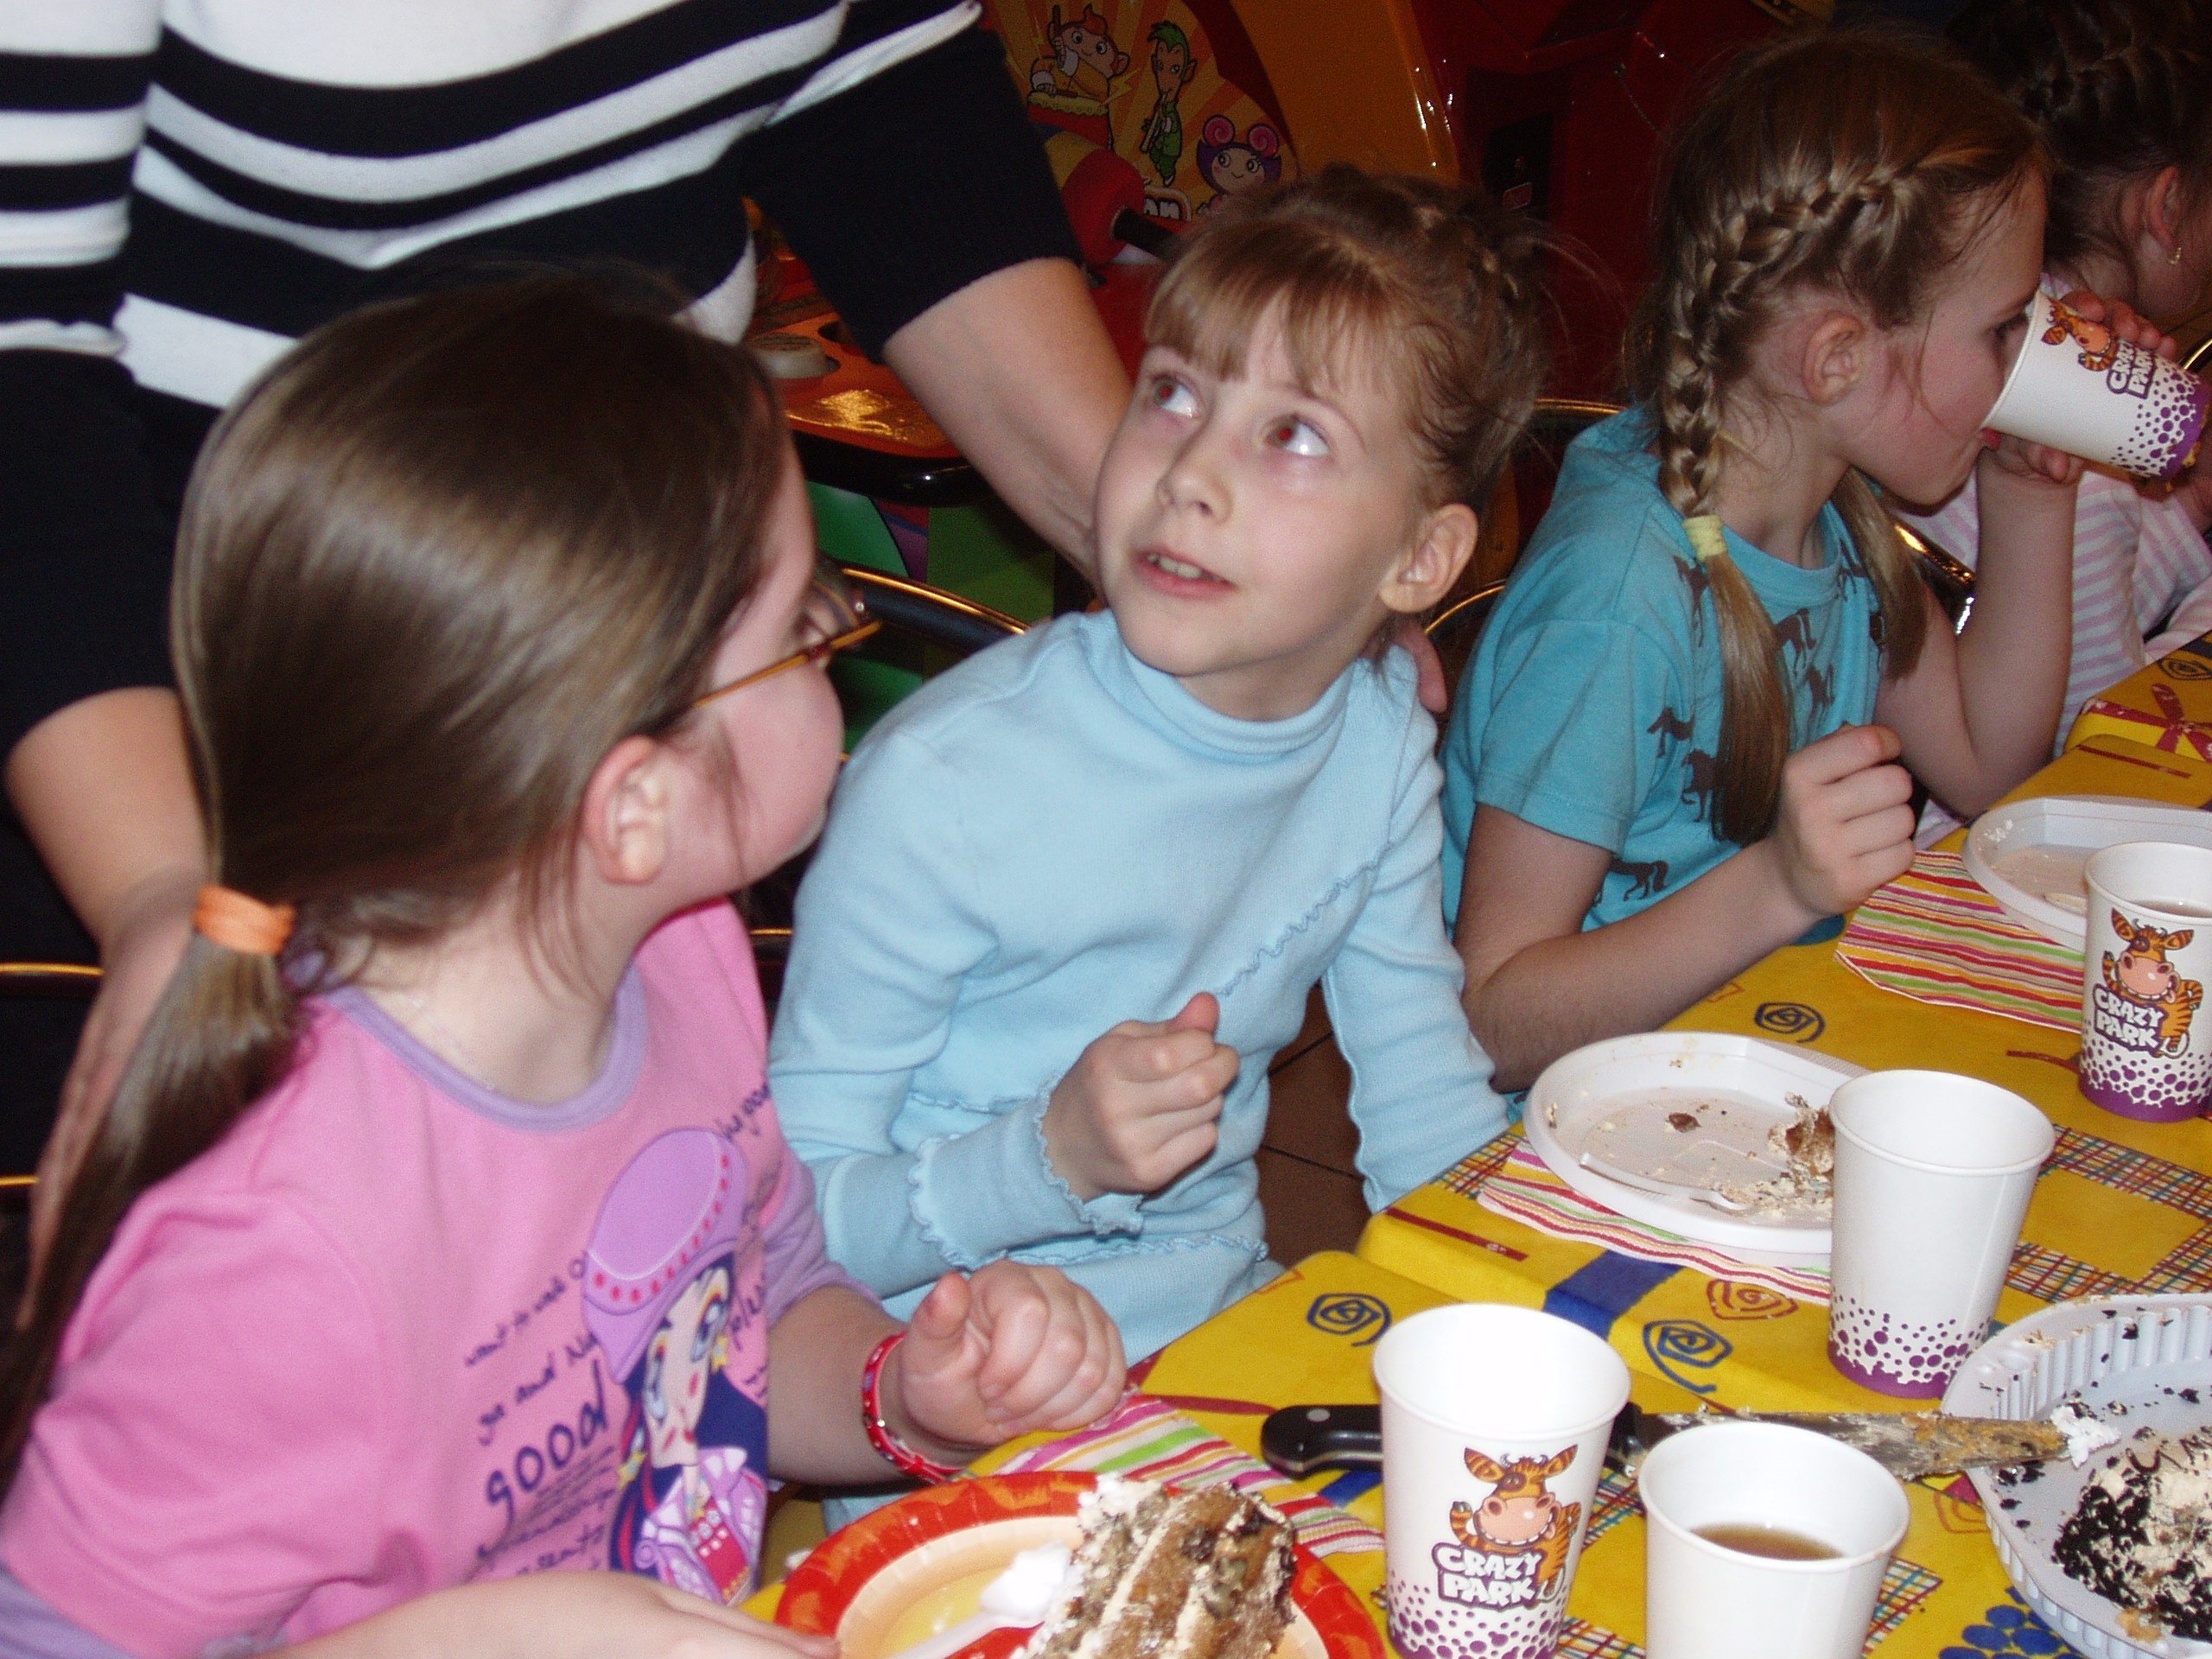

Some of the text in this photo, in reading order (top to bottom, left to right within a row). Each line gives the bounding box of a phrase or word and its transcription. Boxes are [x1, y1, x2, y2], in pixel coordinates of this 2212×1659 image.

[2094, 987, 2164, 1027] CRAZY
[2095, 1008, 2159, 1049] PARK
[486, 1358, 608, 1531] good
[1435, 1548, 1543, 1580] CRAZY
[1442, 1572, 1535, 1606] PARK
